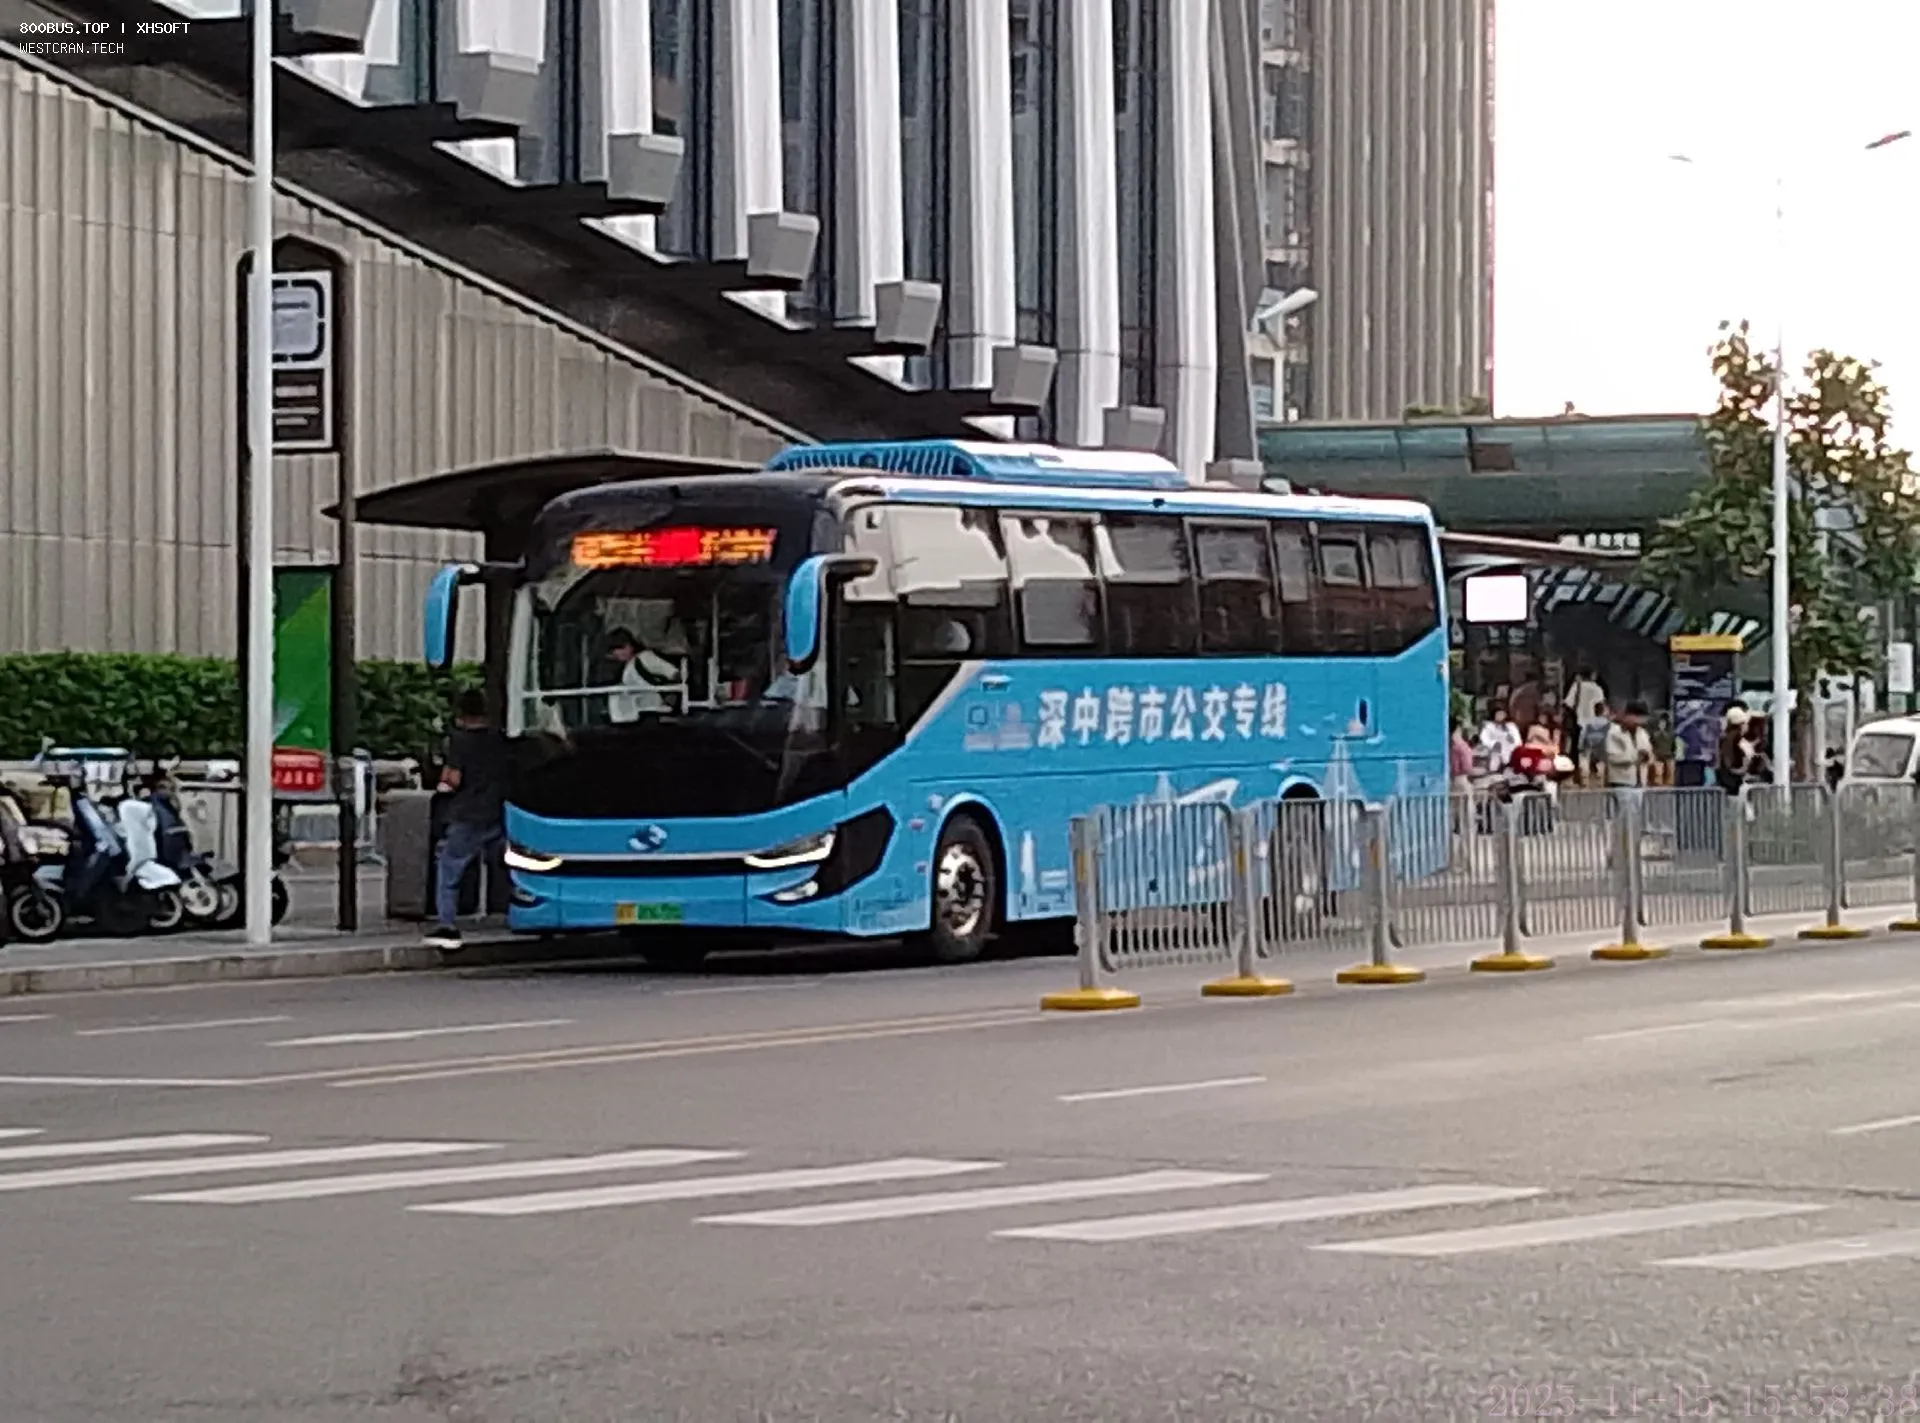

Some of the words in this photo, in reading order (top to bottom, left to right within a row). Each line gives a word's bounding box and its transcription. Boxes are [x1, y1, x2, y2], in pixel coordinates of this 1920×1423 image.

[1037, 681, 1288, 748] 深中跨市公交专线
